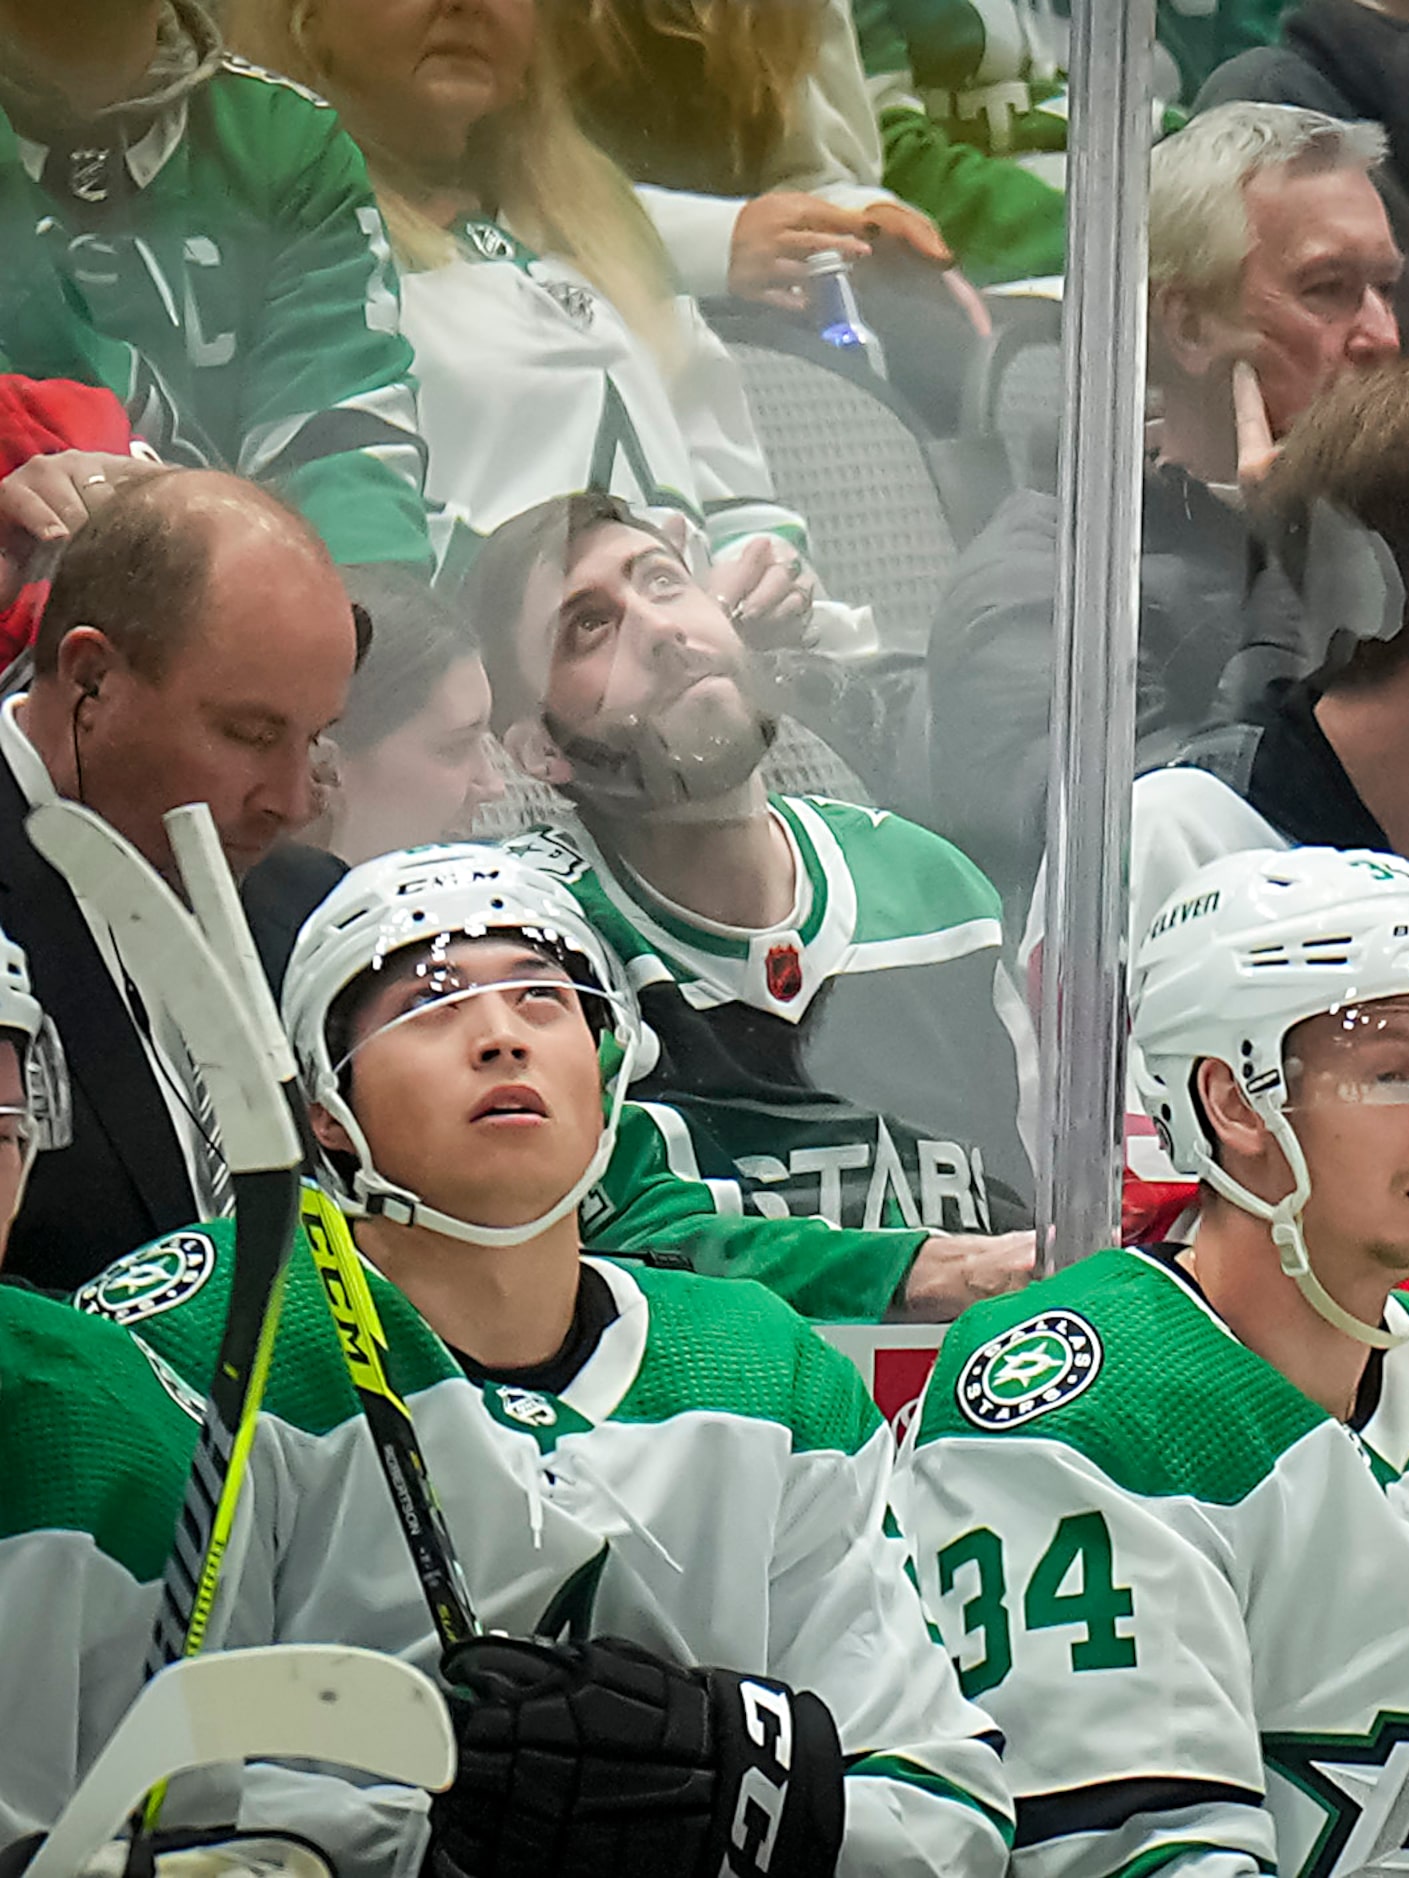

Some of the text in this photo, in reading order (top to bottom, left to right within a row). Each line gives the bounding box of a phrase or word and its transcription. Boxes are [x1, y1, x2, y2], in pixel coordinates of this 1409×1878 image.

[302, 1213, 371, 1367] CCM
[966, 1319, 1092, 1421] DALLAS STARS
[936, 1509, 1138, 1701] 34
[717, 1680, 793, 1878] CC
